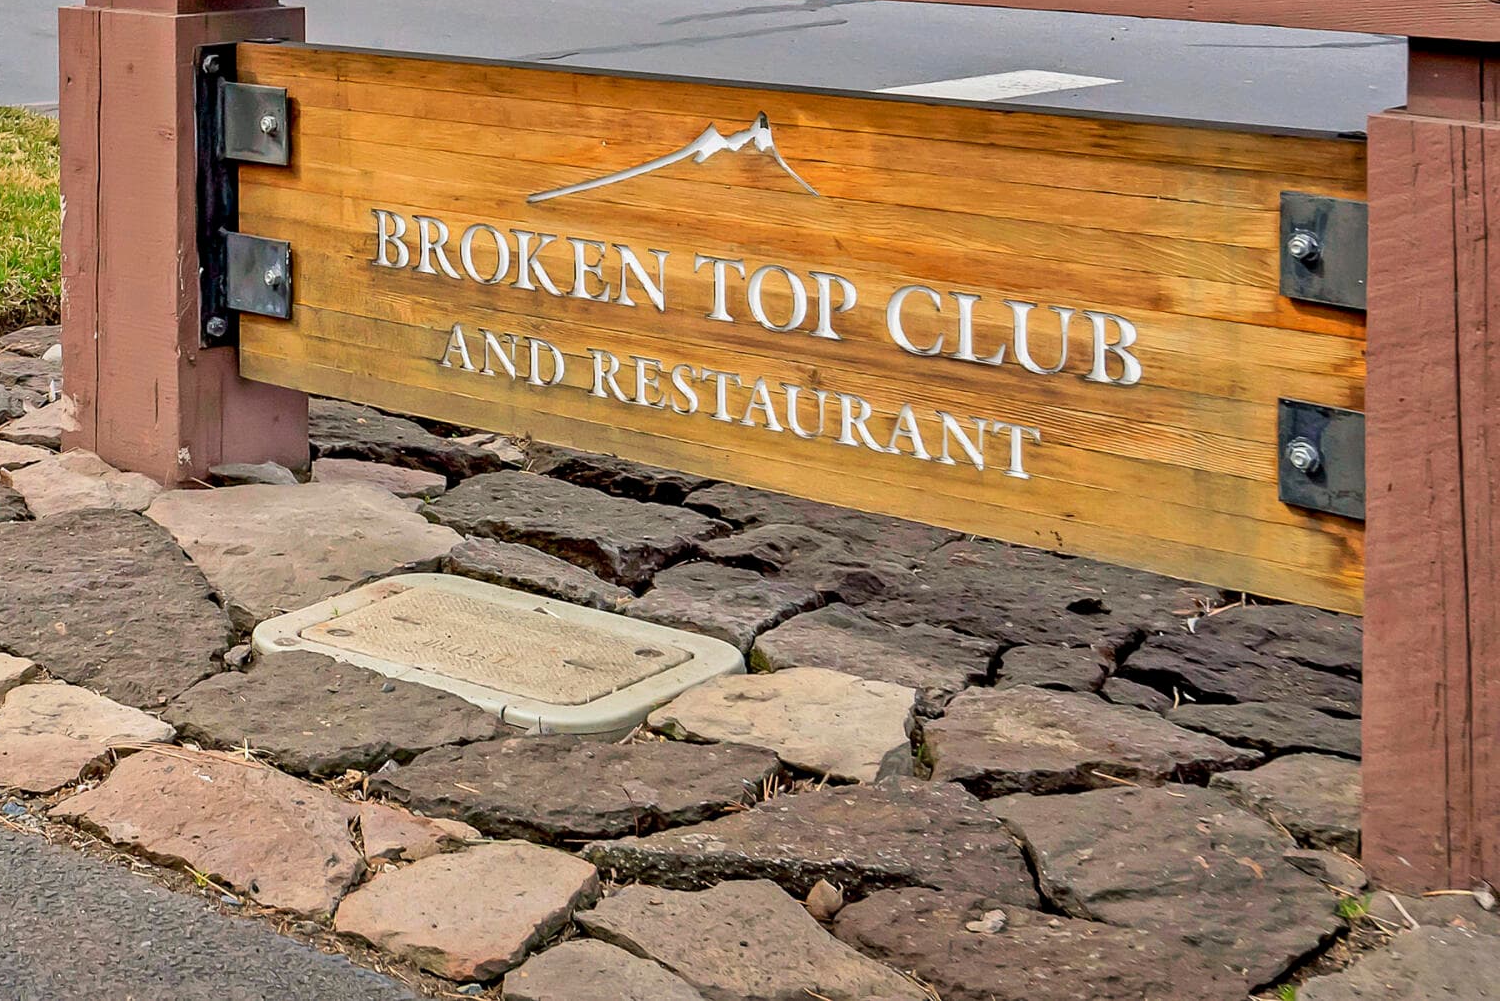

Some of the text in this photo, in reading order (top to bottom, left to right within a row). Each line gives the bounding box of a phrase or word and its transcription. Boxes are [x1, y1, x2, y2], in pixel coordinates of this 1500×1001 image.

[371, 208, 1143, 386] BROKEN TOP CLUB
[440, 324, 1041, 480] AND RESTAURANT
